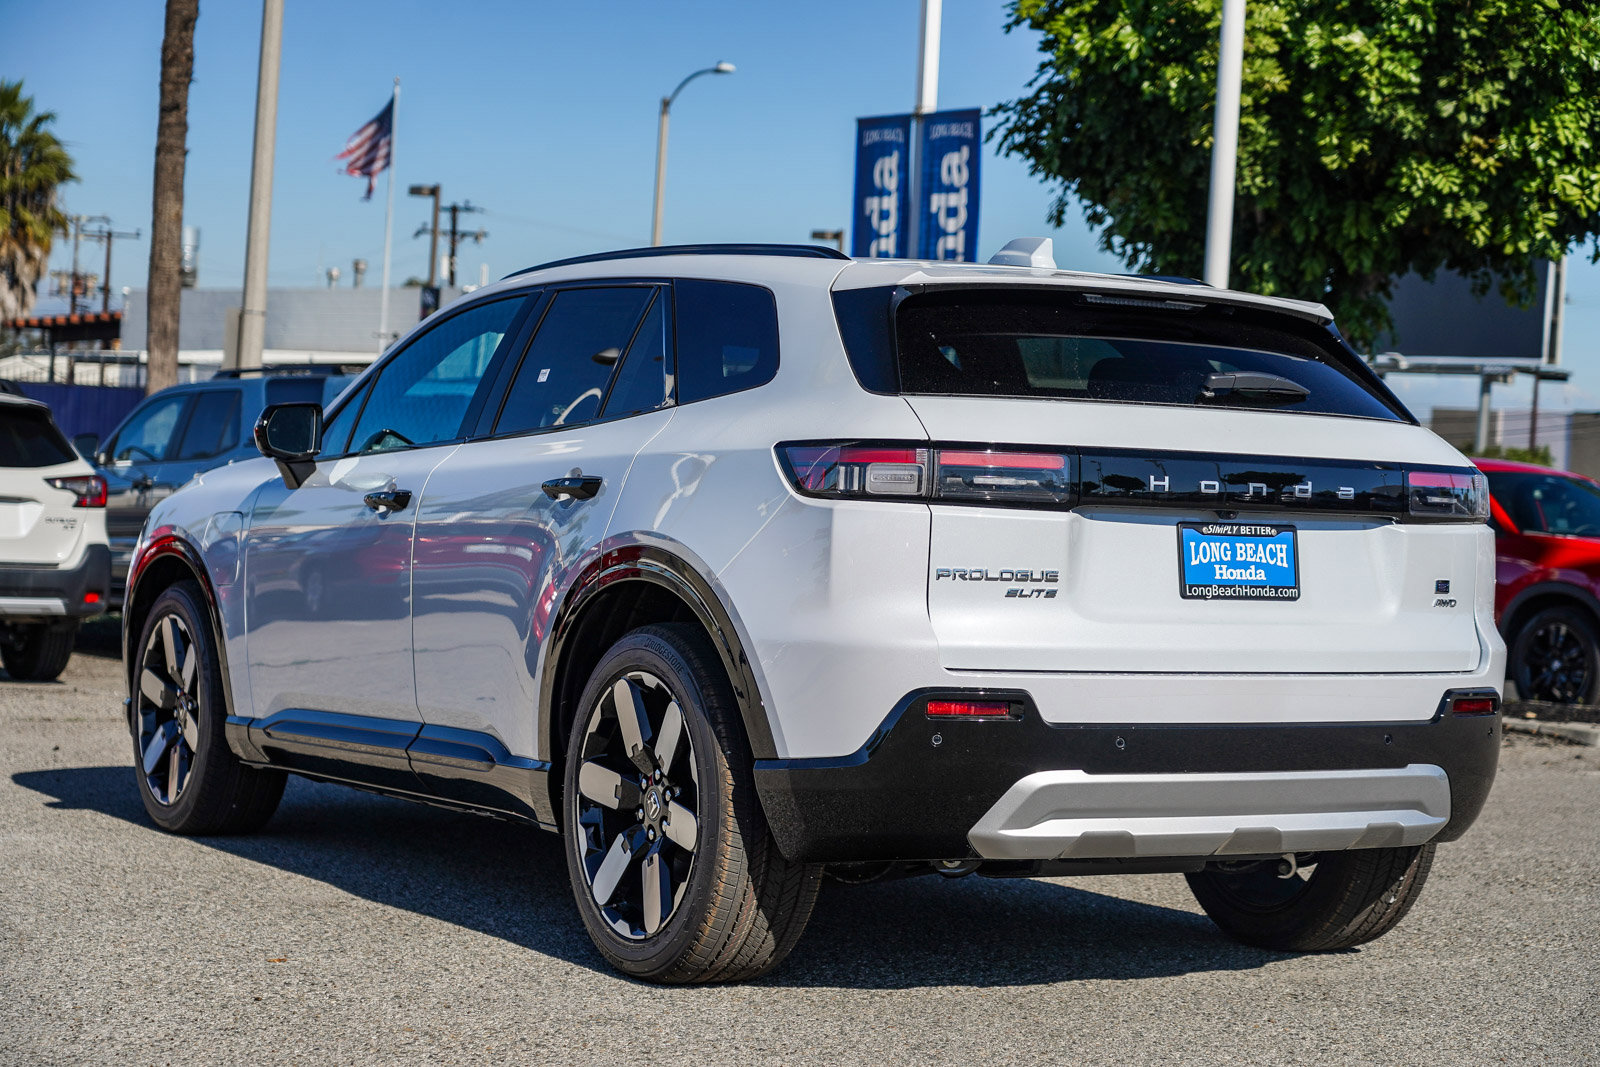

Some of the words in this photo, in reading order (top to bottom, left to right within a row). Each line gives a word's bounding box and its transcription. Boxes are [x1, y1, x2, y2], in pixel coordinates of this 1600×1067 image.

[865, 149, 898, 258] nda
[930, 145, 970, 262] nda
[1150, 475, 1355, 500] Honda
[1207, 524, 1239, 534] SIMPLY
[1240, 526, 1271, 536] BETTER
[1189, 541, 1232, 566] LONG
[1235, 542, 1289, 568] BEACH
[936, 568, 1060, 583] PROLOGUE
[1213, 564, 1267, 581] Honda
[1004, 588, 1058, 599] ELITE
[1186, 584, 1298, 598] LongBeachHonda.com
[1434, 598, 1457, 608] AWD
